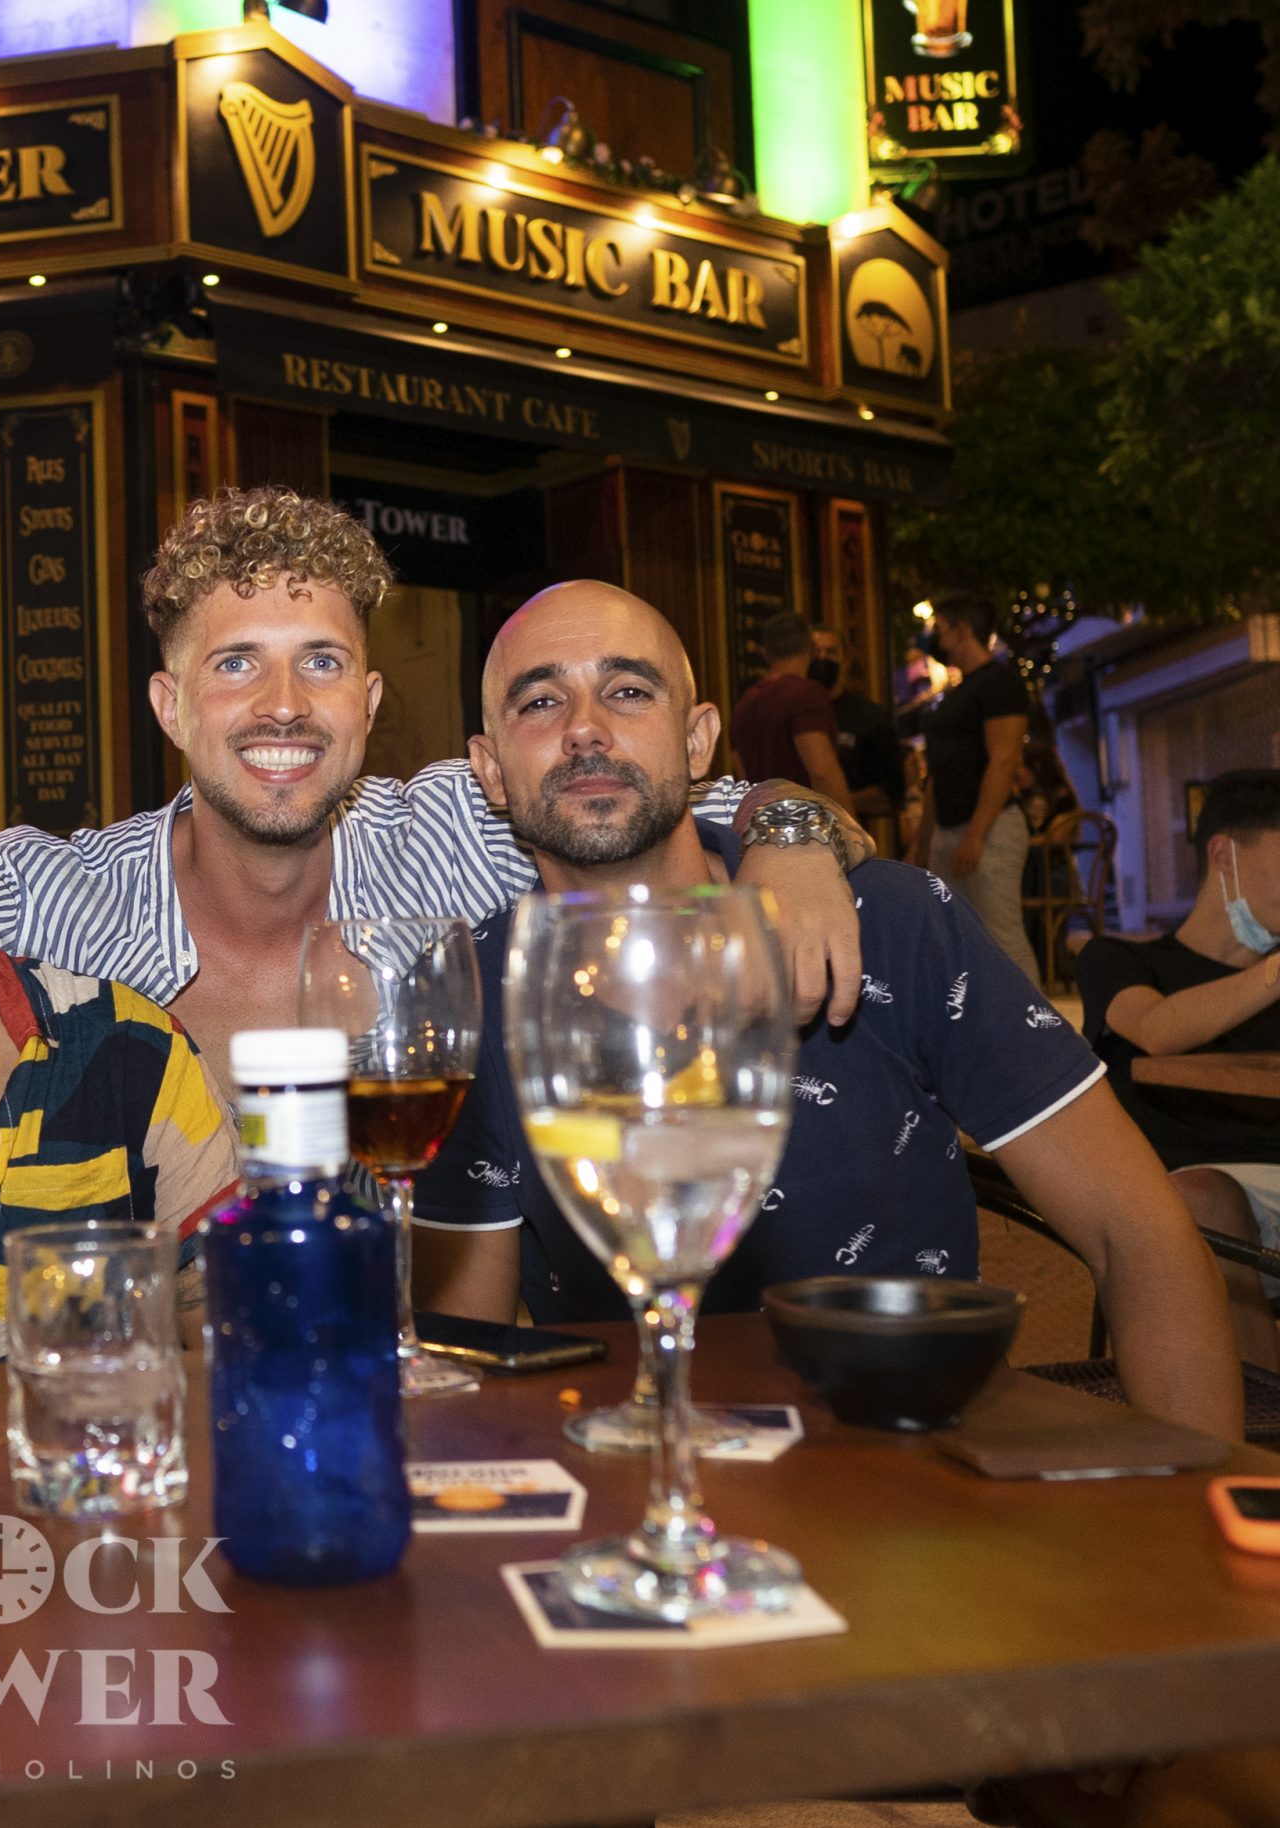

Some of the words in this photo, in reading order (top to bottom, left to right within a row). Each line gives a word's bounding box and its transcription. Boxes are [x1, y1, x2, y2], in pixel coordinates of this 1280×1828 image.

[883, 71, 1000, 104] MUSIC
[907, 102, 980, 132] BAR
[420, 190, 629, 297] MUSIC
[652, 247, 768, 330] BAR
[283, 353, 512, 423] RESTAURANT
[752, 440, 855, 482] SPORTS
[863, 457, 913, 493] BAR
[357, 498, 468, 544] TOWER
